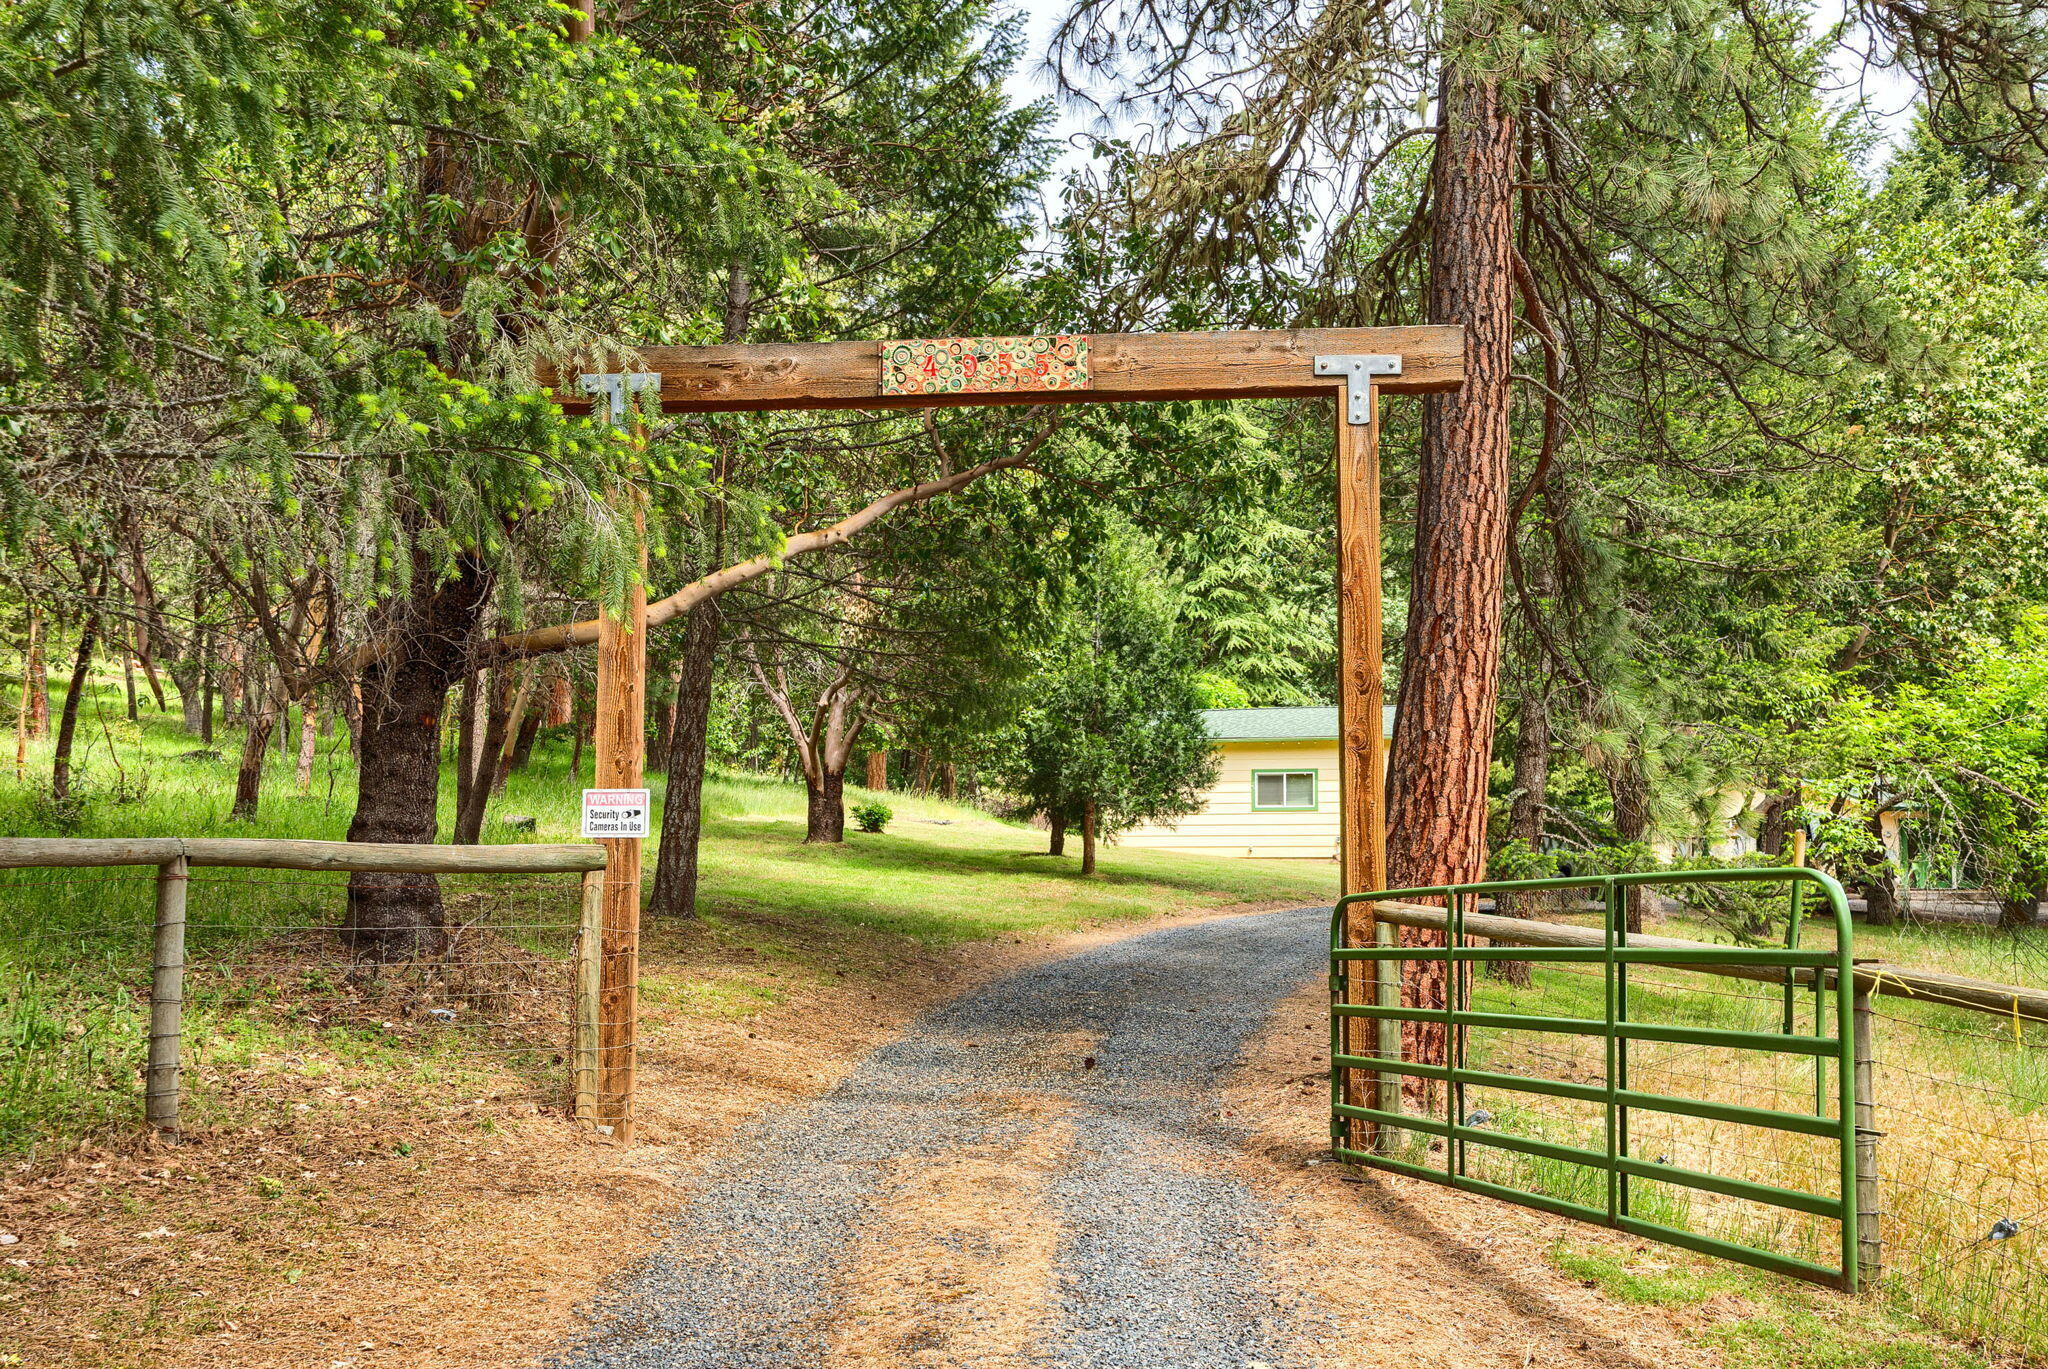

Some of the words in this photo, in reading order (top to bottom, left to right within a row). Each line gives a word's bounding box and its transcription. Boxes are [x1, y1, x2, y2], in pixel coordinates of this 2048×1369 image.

[923, 353, 1049, 378] 4955
[589, 794, 643, 804] WARNING
[590, 809, 619, 821] Security
[590, 821, 618, 831] Cameras
[621, 821, 627, 831] In
[629, 821, 641, 831] Use
